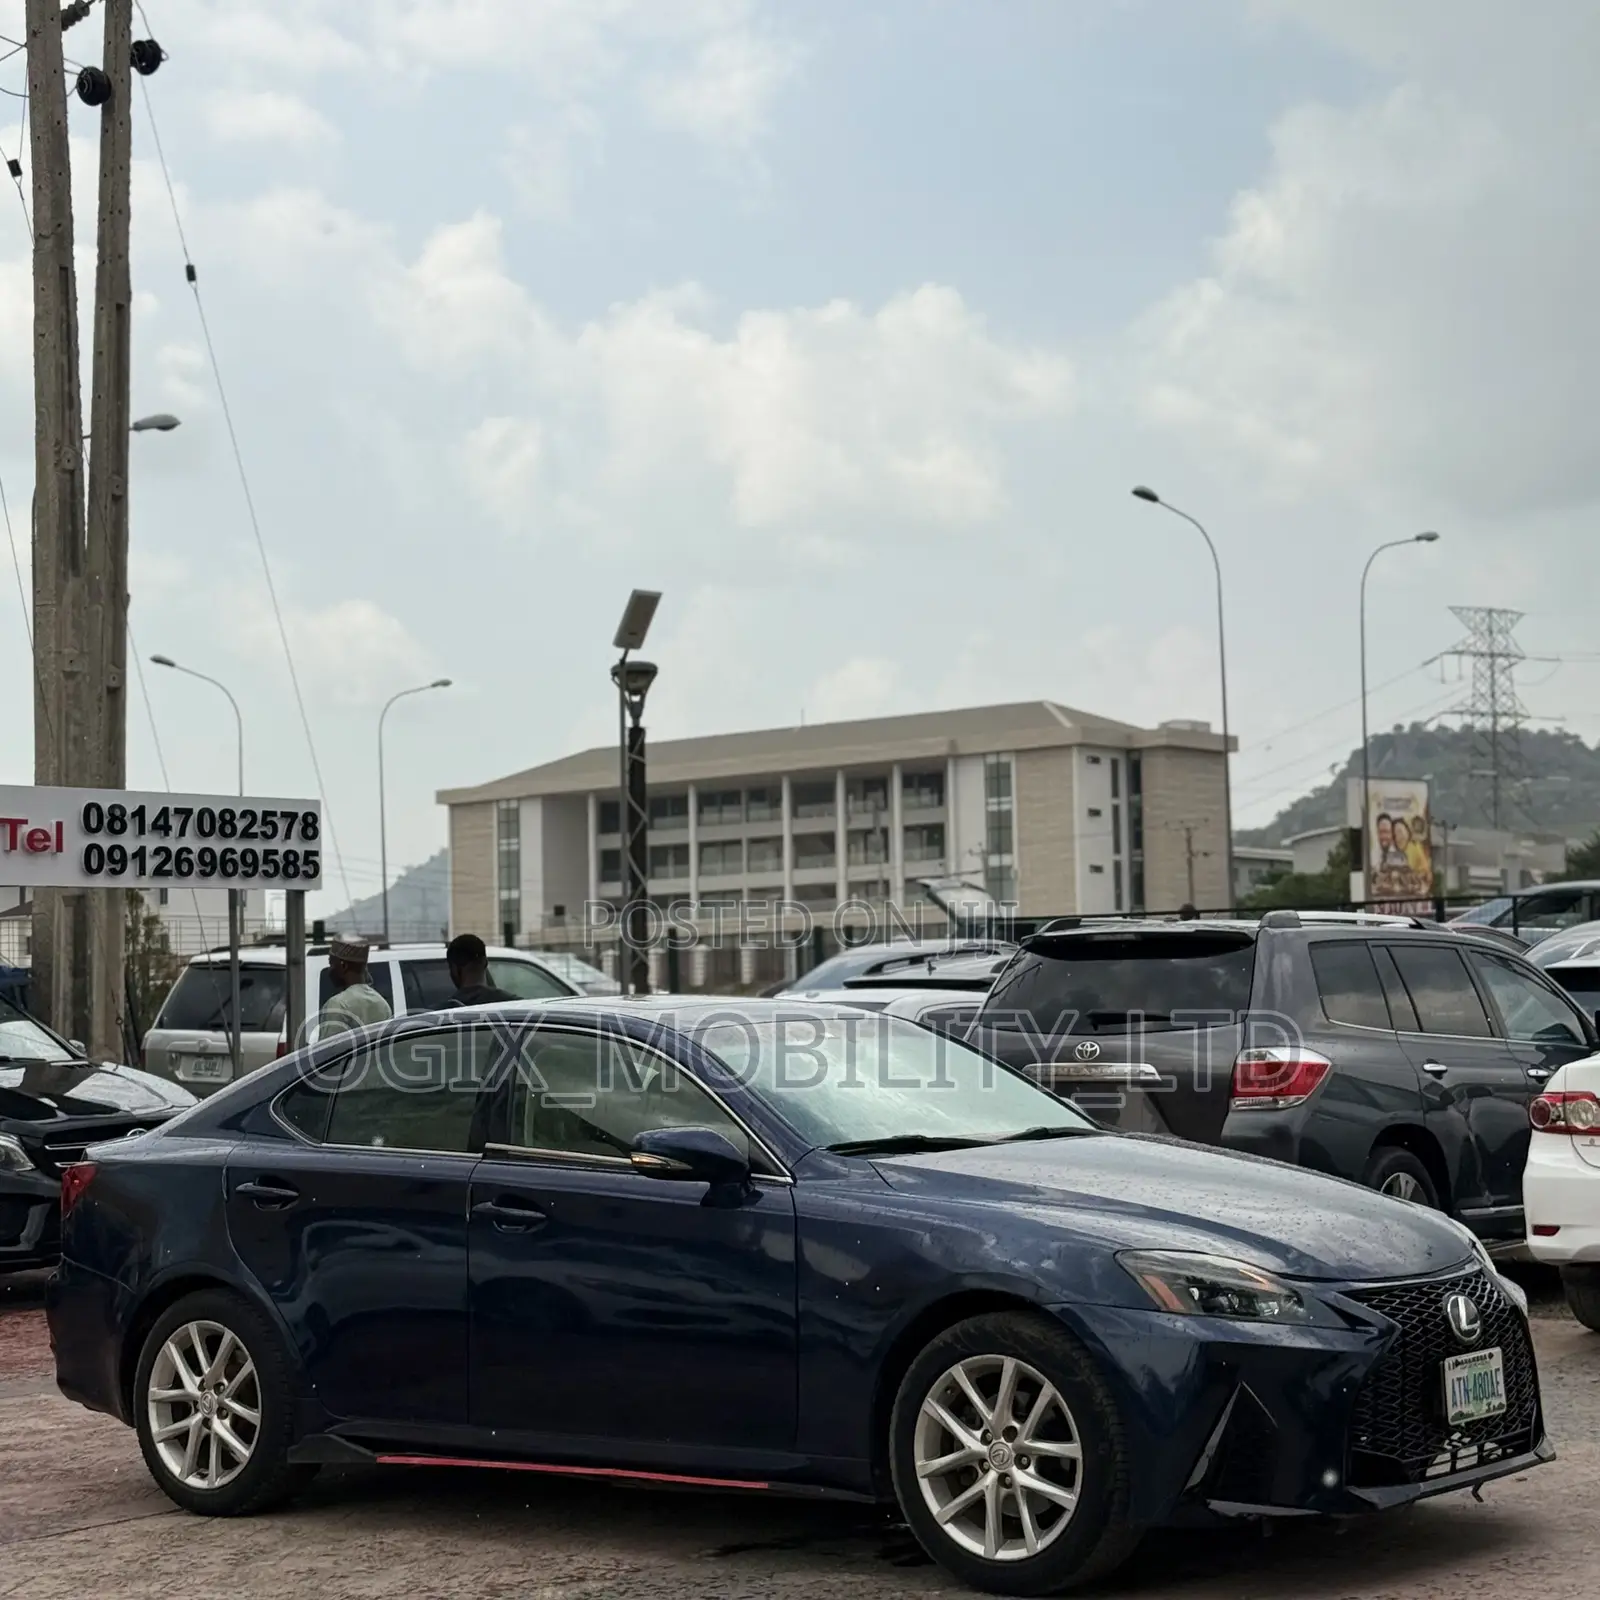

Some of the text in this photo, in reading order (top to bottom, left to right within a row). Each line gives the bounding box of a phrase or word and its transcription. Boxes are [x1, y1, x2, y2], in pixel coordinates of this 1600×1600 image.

[0, 817, 64, 853] Tel
[82, 801, 320, 841] 08147082578
[83, 843, 321, 879] 09126969585
